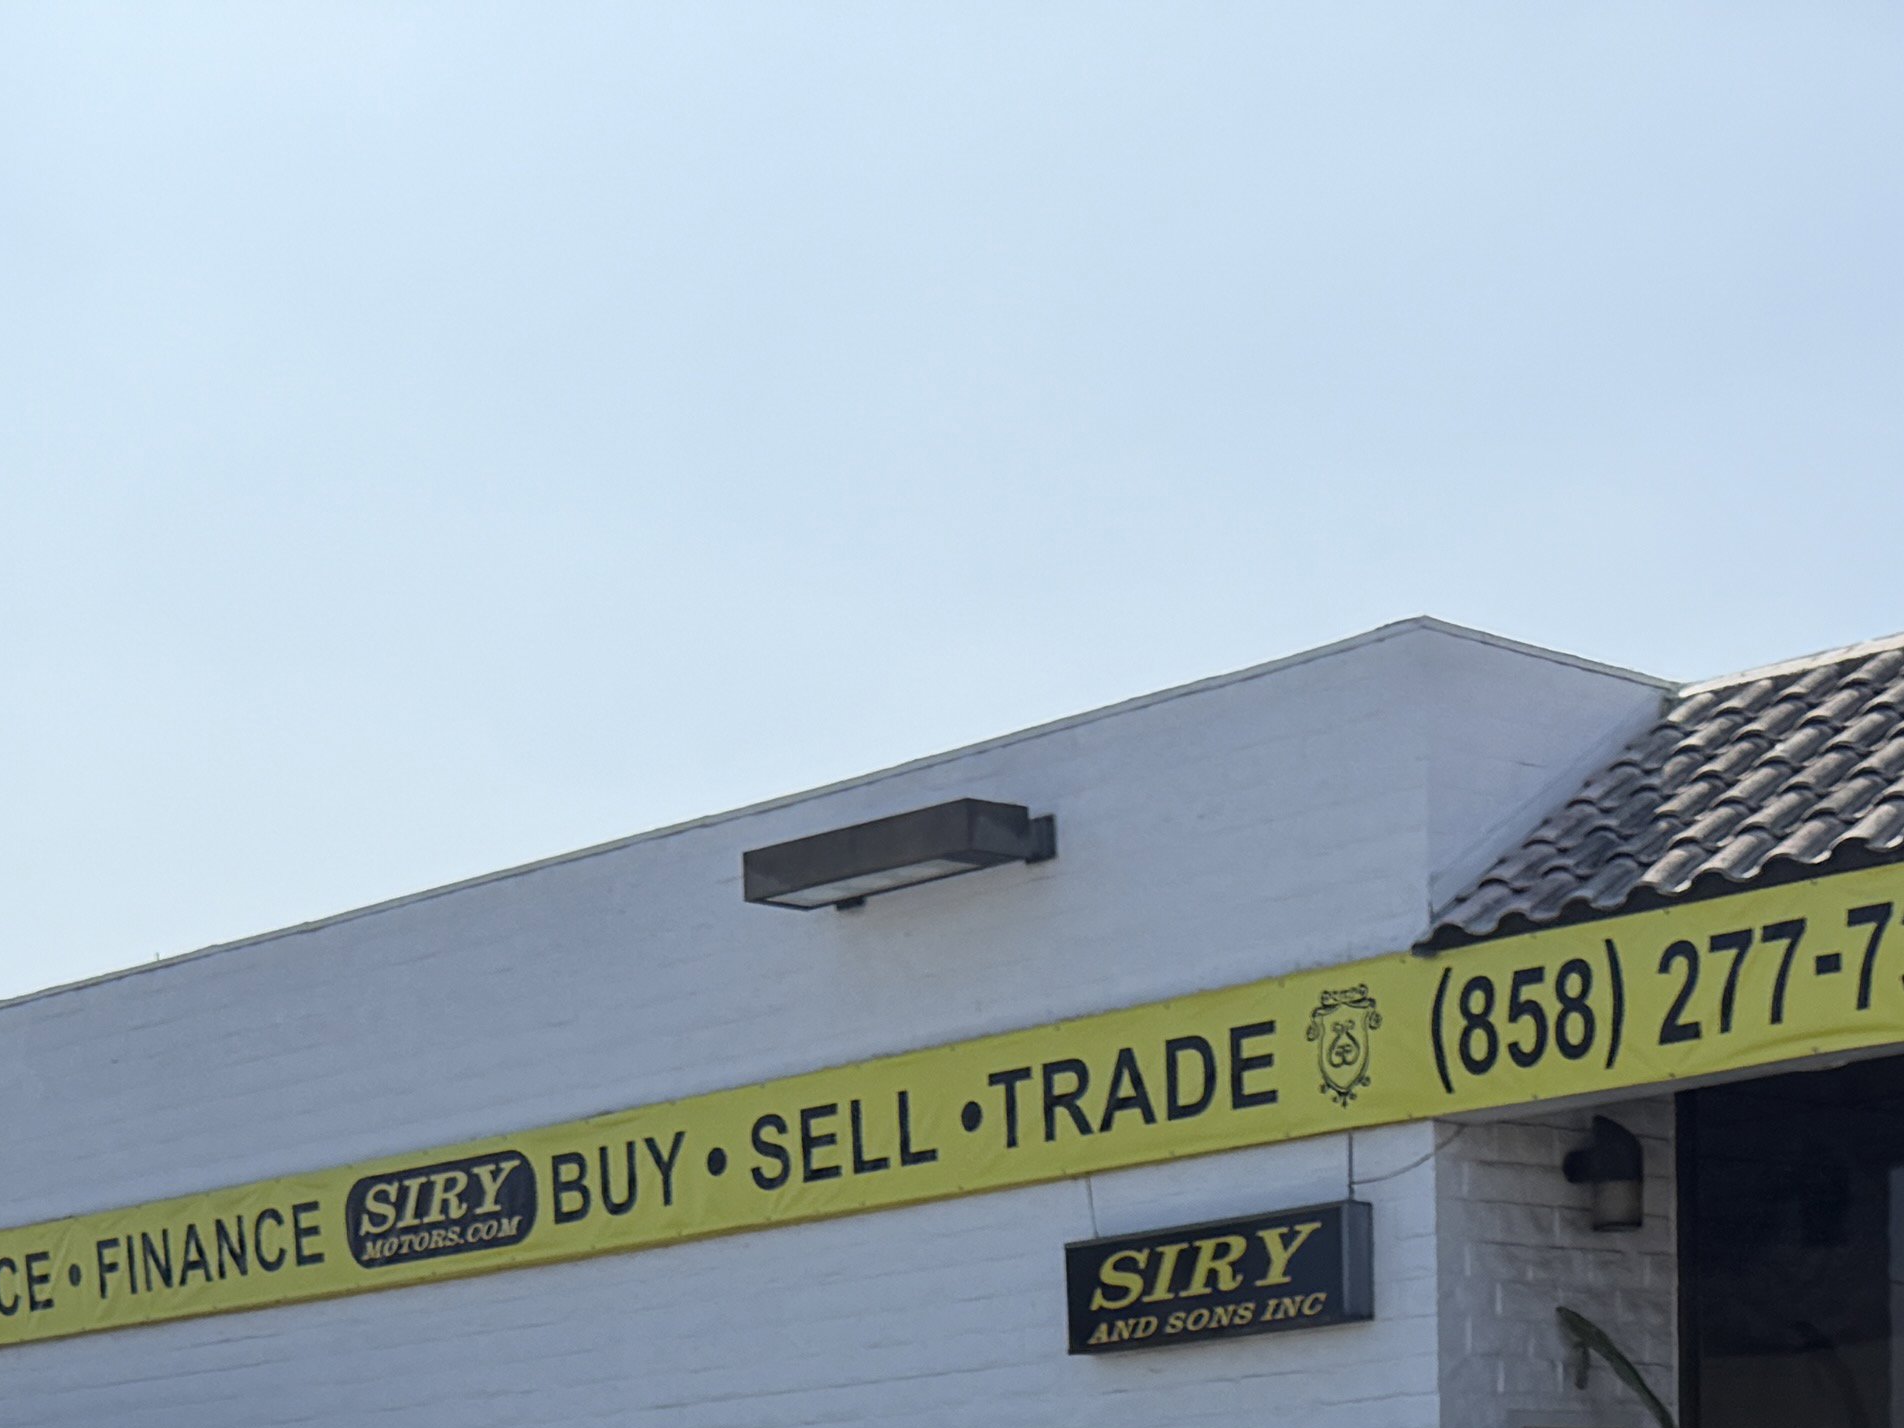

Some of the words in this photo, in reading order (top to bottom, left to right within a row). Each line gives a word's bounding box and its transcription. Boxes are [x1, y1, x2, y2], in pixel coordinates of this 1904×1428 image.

[1430, 939, 1624, 1093] (858)
[552, 1131, 685, 1224] BUY
[751, 1090, 937, 1190] SELL
[988, 1021, 1277, 1148] TRADE
[360, 1159, 522, 1235] SIRY
[363, 1215, 521, 1260] MOTORS.COM
[98, 1201, 325, 1301] FINANCE
[1090, 1222, 1321, 1311] SIRY
[1088, 1316, 1158, 1344] AND
[1166, 1303, 1256, 1334] SONS
[1261, 1292, 1326, 1323] INC
